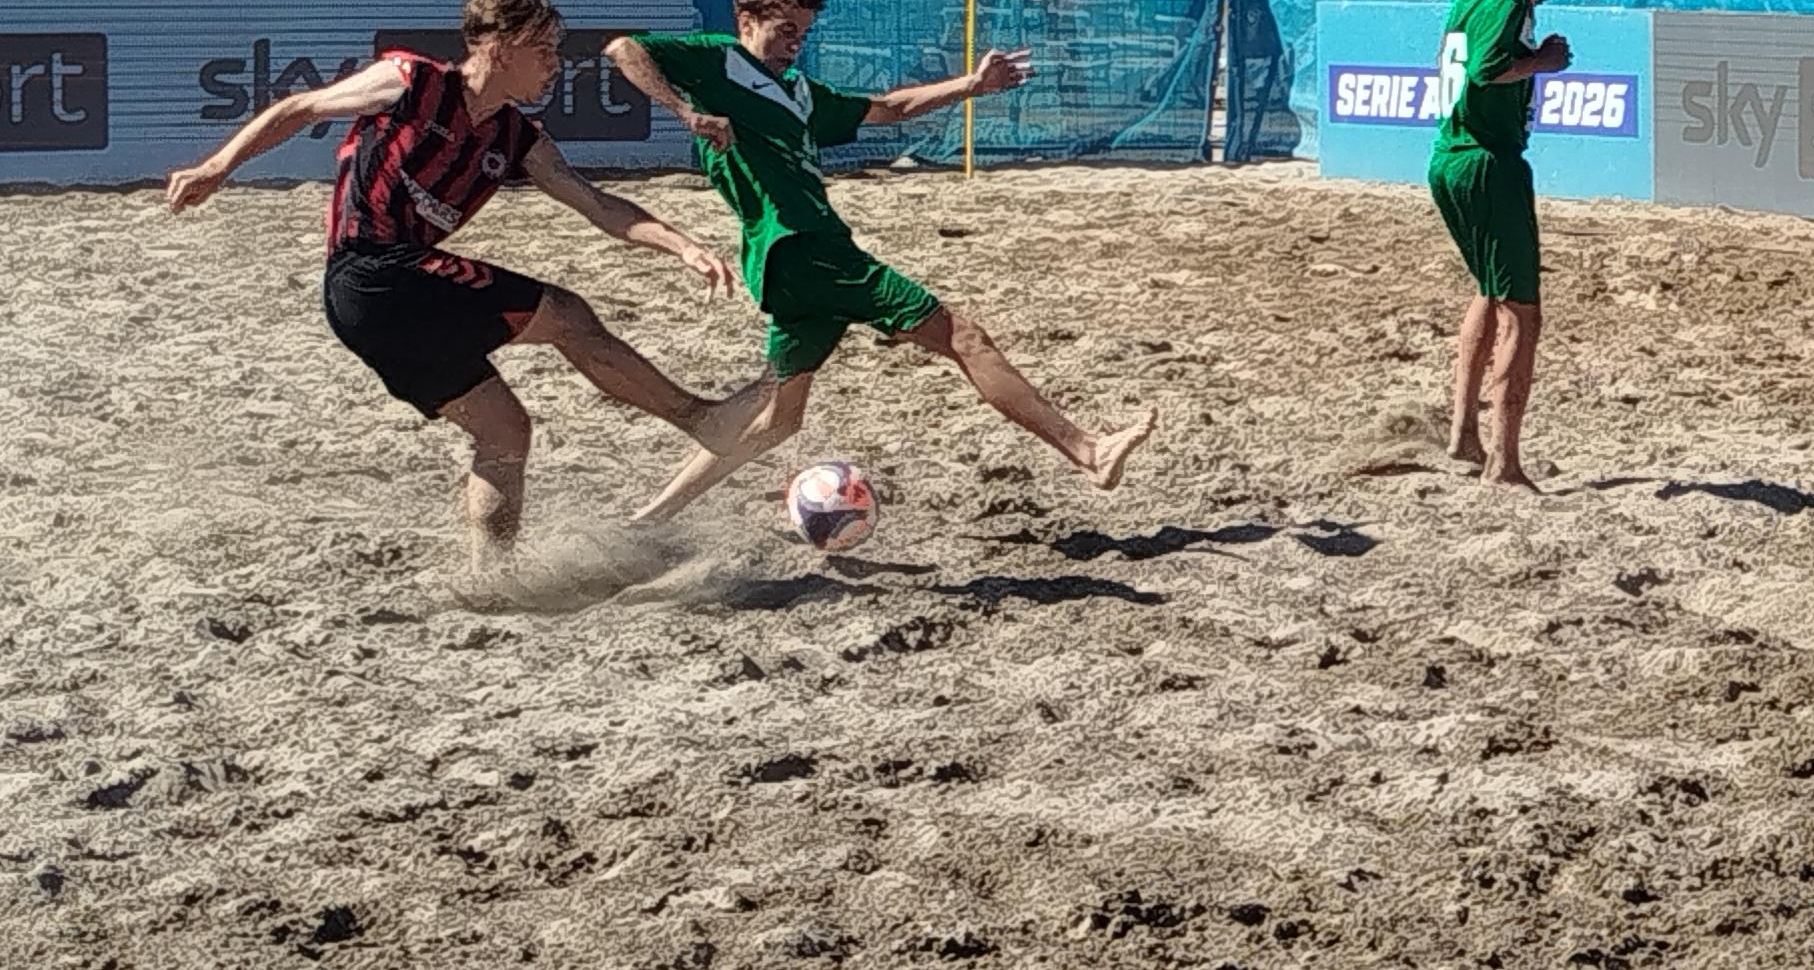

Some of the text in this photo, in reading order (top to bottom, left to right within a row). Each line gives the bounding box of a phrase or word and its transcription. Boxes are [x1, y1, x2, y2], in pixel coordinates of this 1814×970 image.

[1336, 72, 1417, 118] SERIE
[1540, 81, 1628, 128] 2026
[1681, 60, 1788, 168] sky
